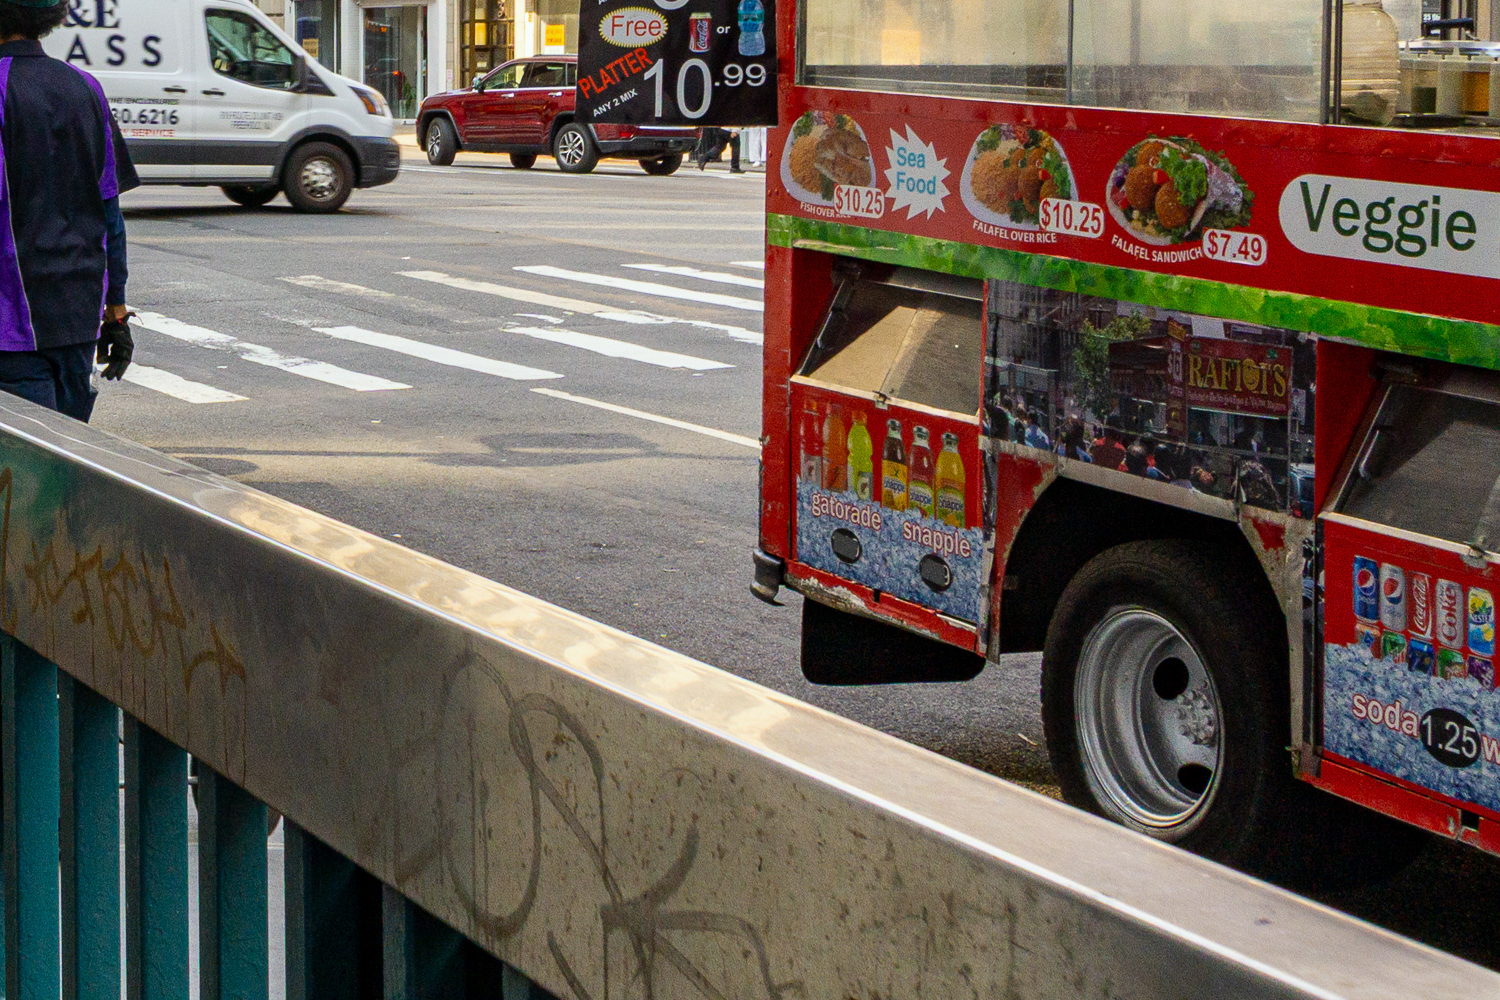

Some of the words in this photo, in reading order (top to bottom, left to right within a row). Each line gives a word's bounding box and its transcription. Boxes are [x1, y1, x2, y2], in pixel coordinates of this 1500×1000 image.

[610, 14, 662, 38] Free
[716, 24, 731, 35] or
[577, 47, 654, 100] PLATTER
[592, 102, 612, 119] ANY
[613, 97, 621, 108] 2
[621, 88, 639, 104] MIX
[896, 147, 926, 169] Sea
[896, 171, 937, 196] Food
[800, 202, 815, 213] FISH
[816, 205, 837, 218] OVER
[835, 185, 883, 217] $10.25
[1041, 199, 1102, 235] $10.25
[972, 220, 1009, 241] FALAFEL
[1010, 229, 1034, 243] OVER
[1035, 232, 1058, 244] RICE
[1300, 180, 1478, 258] Veggie
[1111, 233, 1150, 262] FALAFEL
[1152, 245, 1202, 263] SANDWICH
[1206, 229, 1263, 262] $7.49
[811, 492, 882, 531] gatorade
[902, 519, 971, 558] snapple
[1352, 693, 1419, 738] soda
[1421, 715, 1477, 759] 1.25
